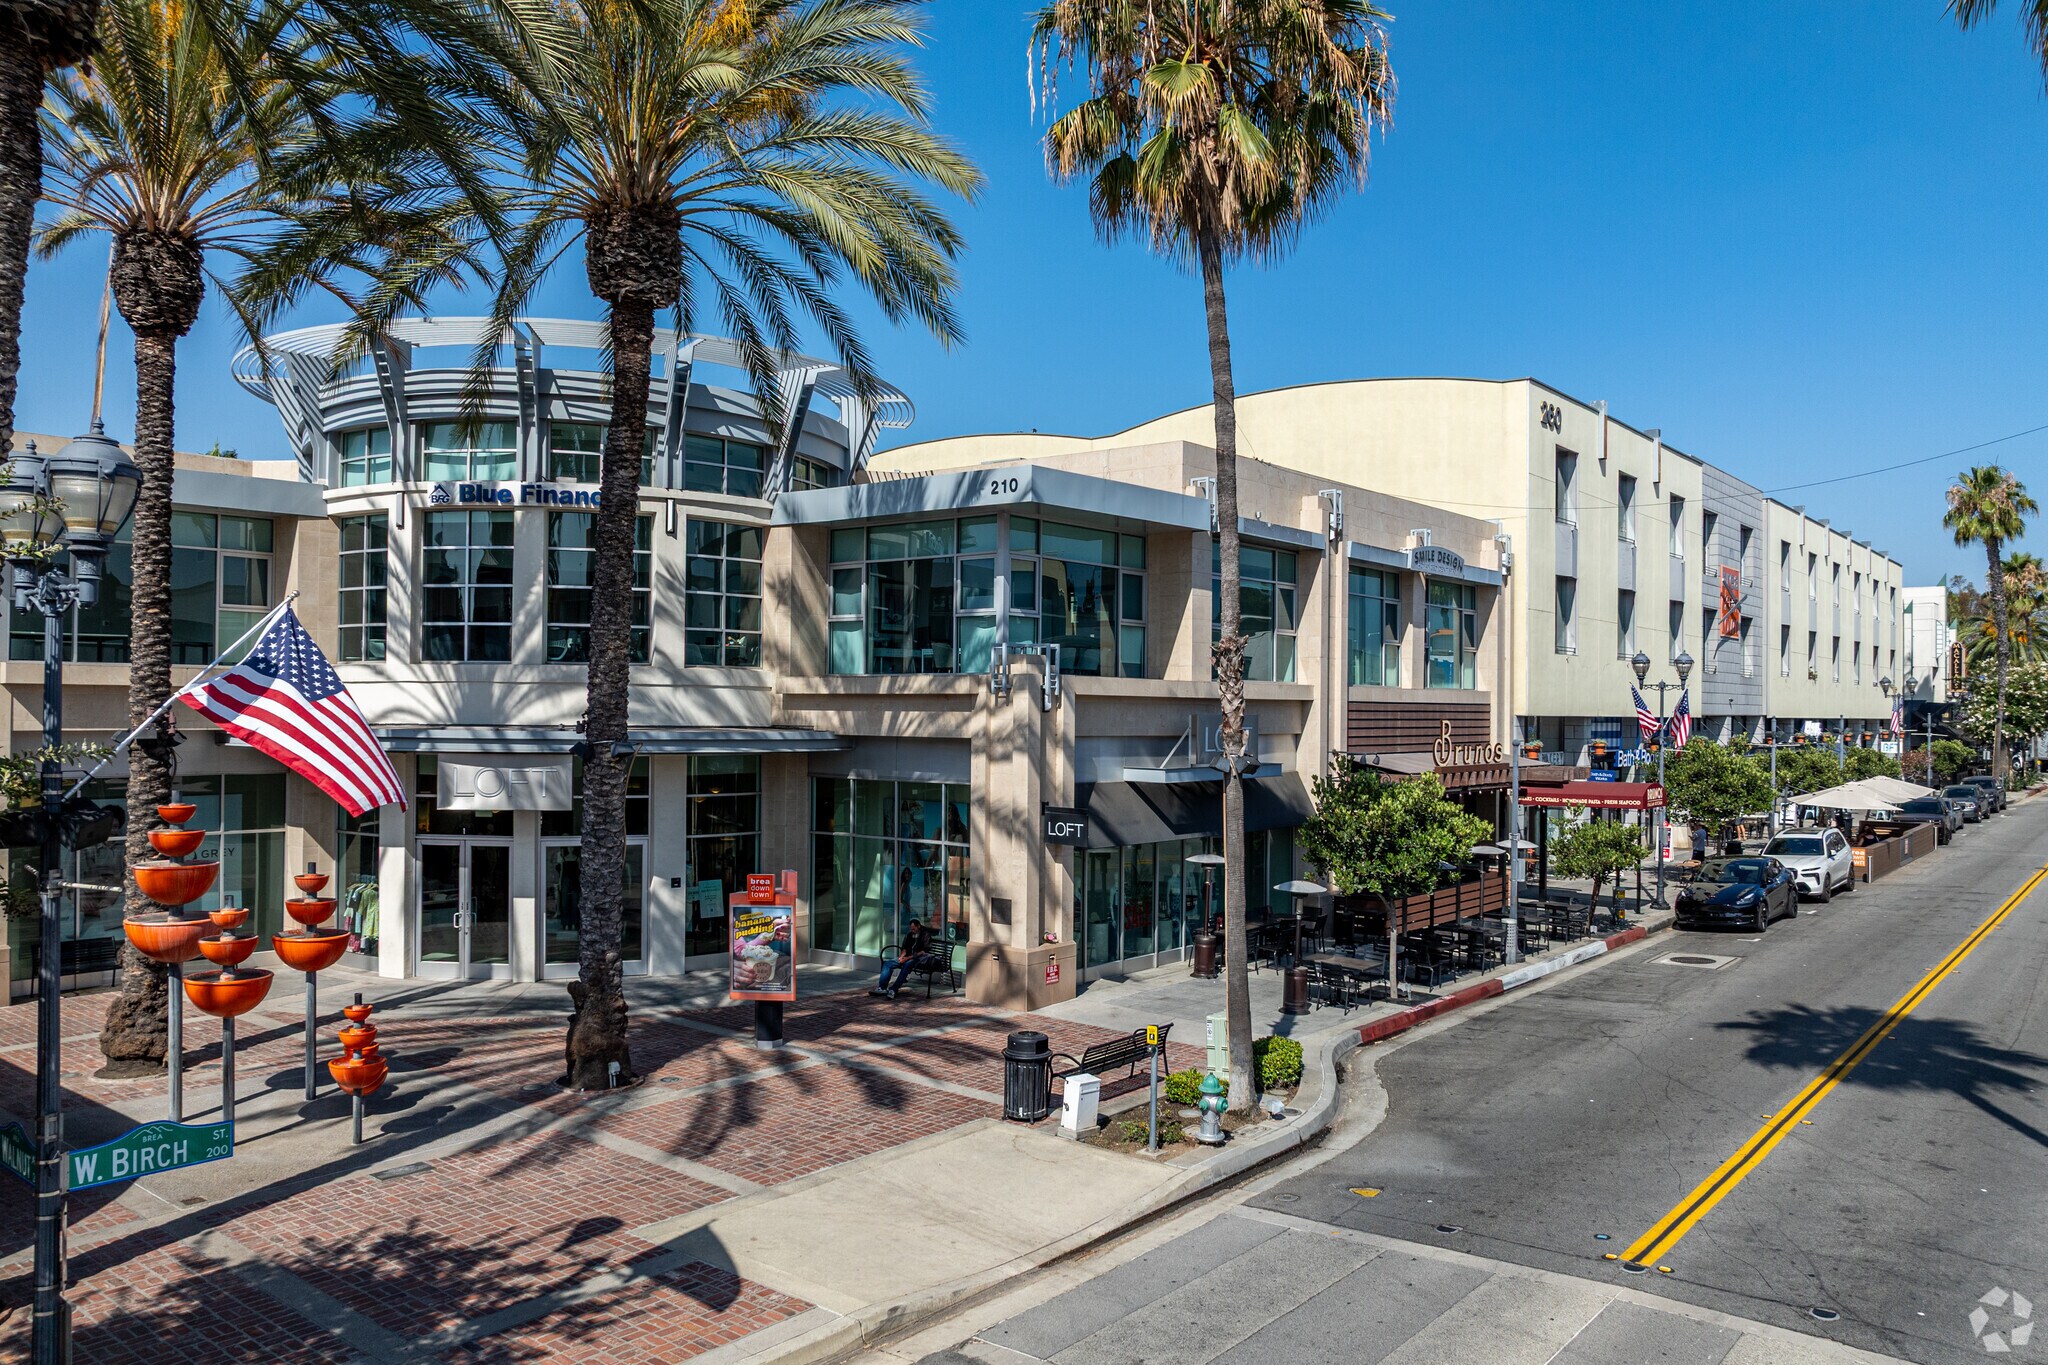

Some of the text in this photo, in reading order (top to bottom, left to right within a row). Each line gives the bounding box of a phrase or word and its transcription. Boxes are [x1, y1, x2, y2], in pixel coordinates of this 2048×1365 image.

[1540, 401, 1562, 434] 260
[459, 484, 513, 503] Blue
[991, 478, 1018, 495] 210
[1414, 550, 1435, 565] SMILE
[1437, 551, 1463, 573] DESIGN
[1205, 726, 1253, 753] LT
[1433, 719, 1503, 767] Brunos
[1618, 750, 1635, 767] Bath
[453, 766, 558, 798] LOFT
[1048, 822, 1084, 838] LOFT
[735, 916, 771, 928] banana
[735, 923, 774, 940] pudding
[142, 1133, 163, 1143] BREA
[212, 1128, 229, 1140] ST.
[206, 1144, 229, 1159] 200
[74, 1139, 188, 1185] W. BIRCH
